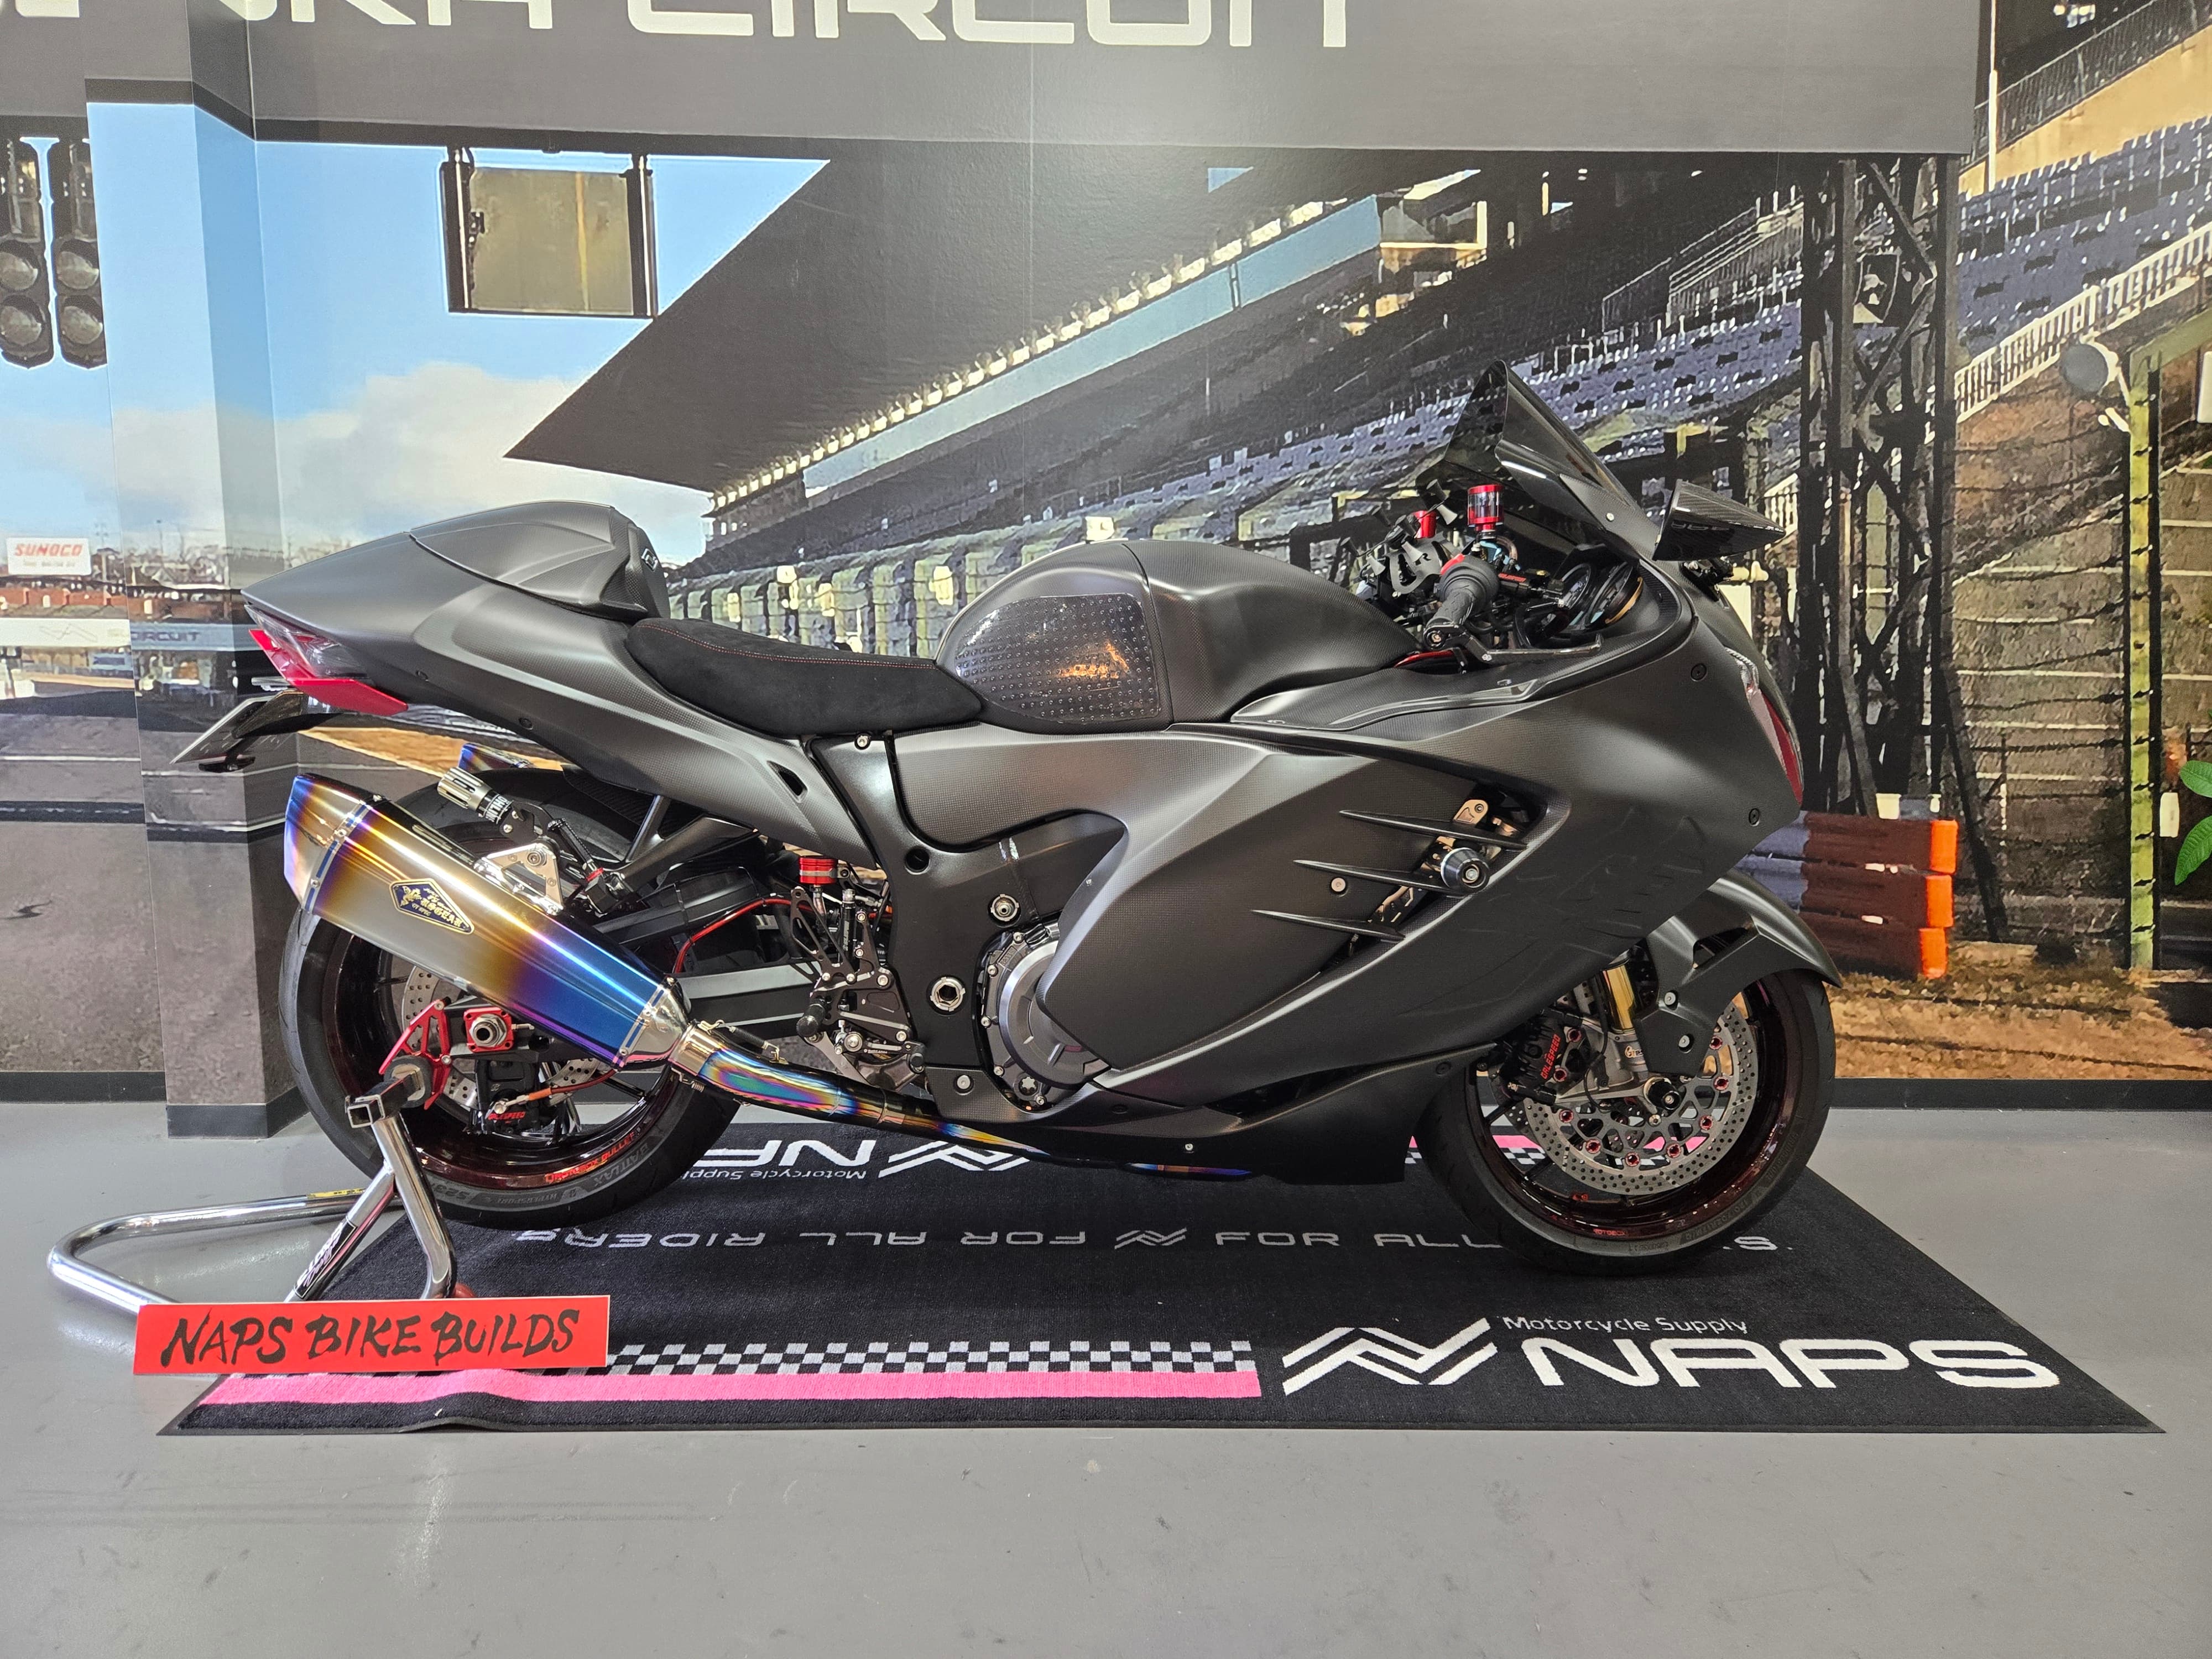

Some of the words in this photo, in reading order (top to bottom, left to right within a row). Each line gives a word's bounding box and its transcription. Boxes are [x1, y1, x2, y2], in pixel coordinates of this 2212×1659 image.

[15, 543, 83, 556] SUNOCO
[1541, 1034, 1561, 1079] GALESPEED
[593, 1142, 650, 1187] BATTLAX
[682, 1169, 744, 1180] Suppl
[750, 1169, 867, 1180] Motorcycle
[496, 1192, 557, 1204] HYPERSPORT
[800, 1232, 926, 1245] ALL
[961, 1232, 1086, 1245] FOR
[1215, 1232, 1340, 1246] FOR
[1374, 1233, 1504, 1248] ALL
[1503, 1316, 1651, 1333] Motorcycle
[1655, 1317, 1748, 1334] Supply
[160, 1308, 293, 1368] NAPS
[304, 1313, 421, 1359] BIKE
[431, 1309, 580, 1366] BUILDS
[1521, 1337, 2059, 1389] NAPS
